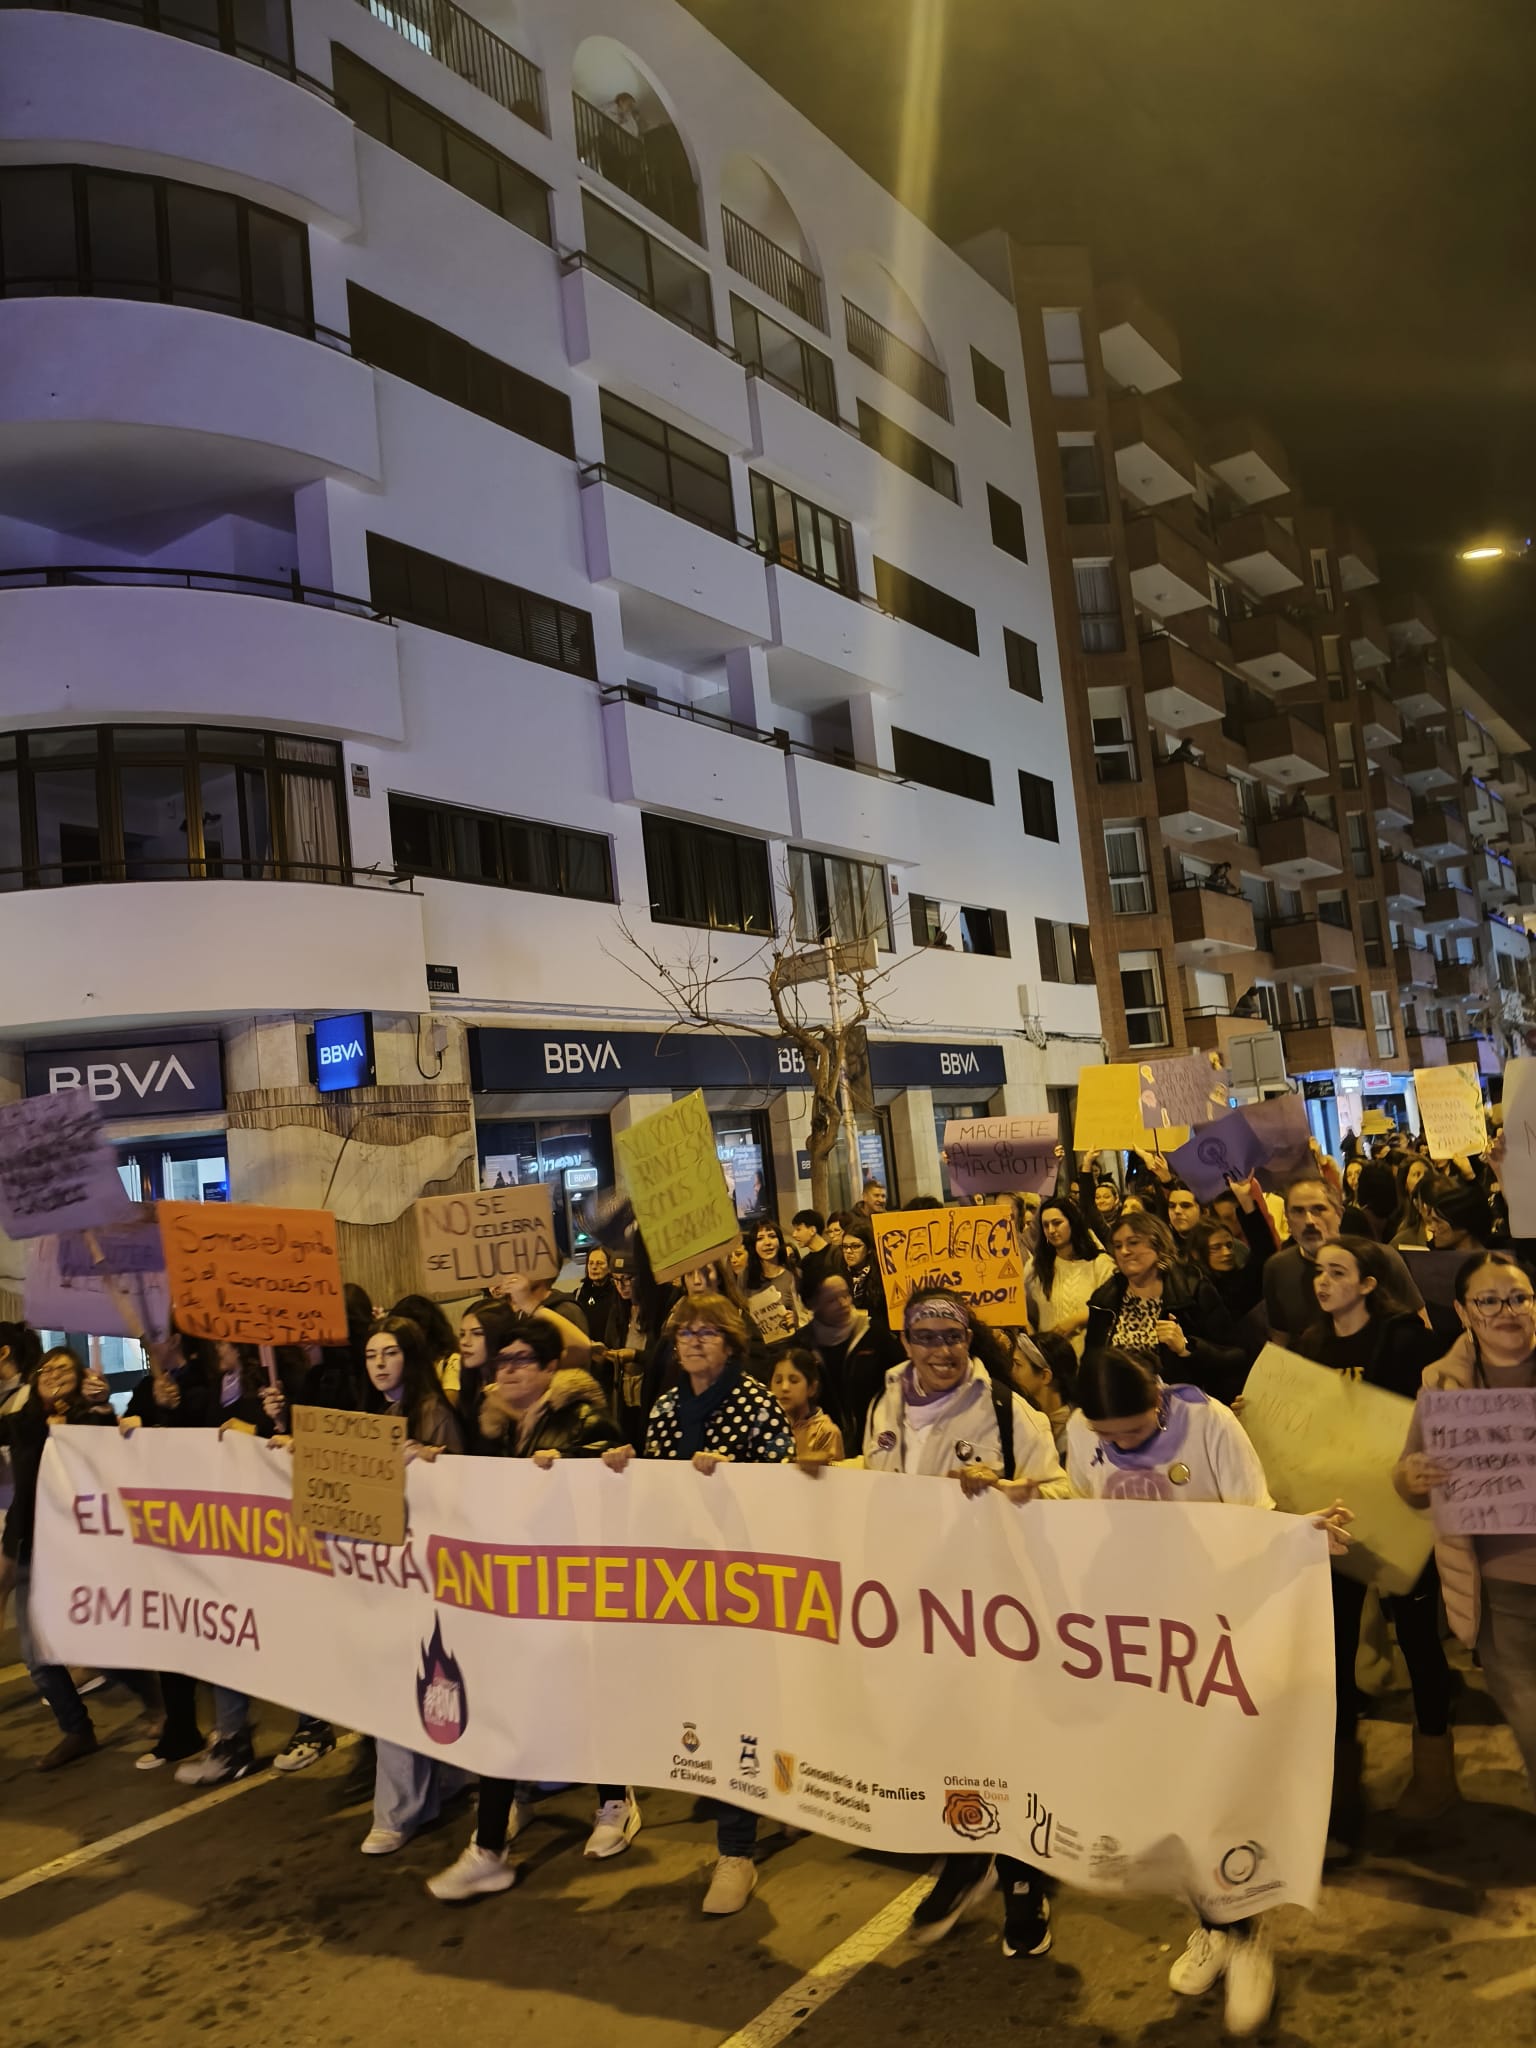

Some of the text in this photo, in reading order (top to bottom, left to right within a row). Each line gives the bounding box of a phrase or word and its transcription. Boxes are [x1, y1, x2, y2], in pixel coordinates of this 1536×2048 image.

[320, 1039, 364, 1065] BBVA
[544, 1040, 622, 1074] BBVA
[940, 1051, 980, 1075] BBVA
[48, 1054, 196, 1102] BBVA
[960, 1120, 1051, 1141] MACHETE
[951, 1142, 983, 1162] AL
[952, 1155, 1057, 1181] MACHOTE
[422, 1195, 506, 1239] NO SE
[472, 1216, 547, 1239] CELEBRA
[426, 1234, 560, 1281] SE LUCHA
[227, 1272, 338, 1296] corazón
[73, 1493, 125, 1537] EL
[121, 1499, 335, 1571] FEMINISME
[435, 1546, 839, 1640] ANTIFEIXISTA
[851, 1579, 899, 1649] O
[918, 1588, 1040, 1662] NO
[1056, 1612, 1260, 1717] SERÀ
[67, 1586, 261, 1652] 8M EIVISSA
[672, 1754, 713, 1771] Consell
[670, 1767, 717, 1786] d'Eivissa
[944, 1775, 1009, 1789] Oficina de la
[855, 1779, 869, 1794] de
[872, 1782, 927, 1802] Famílies
[983, 1790, 1010, 1801] Dona
